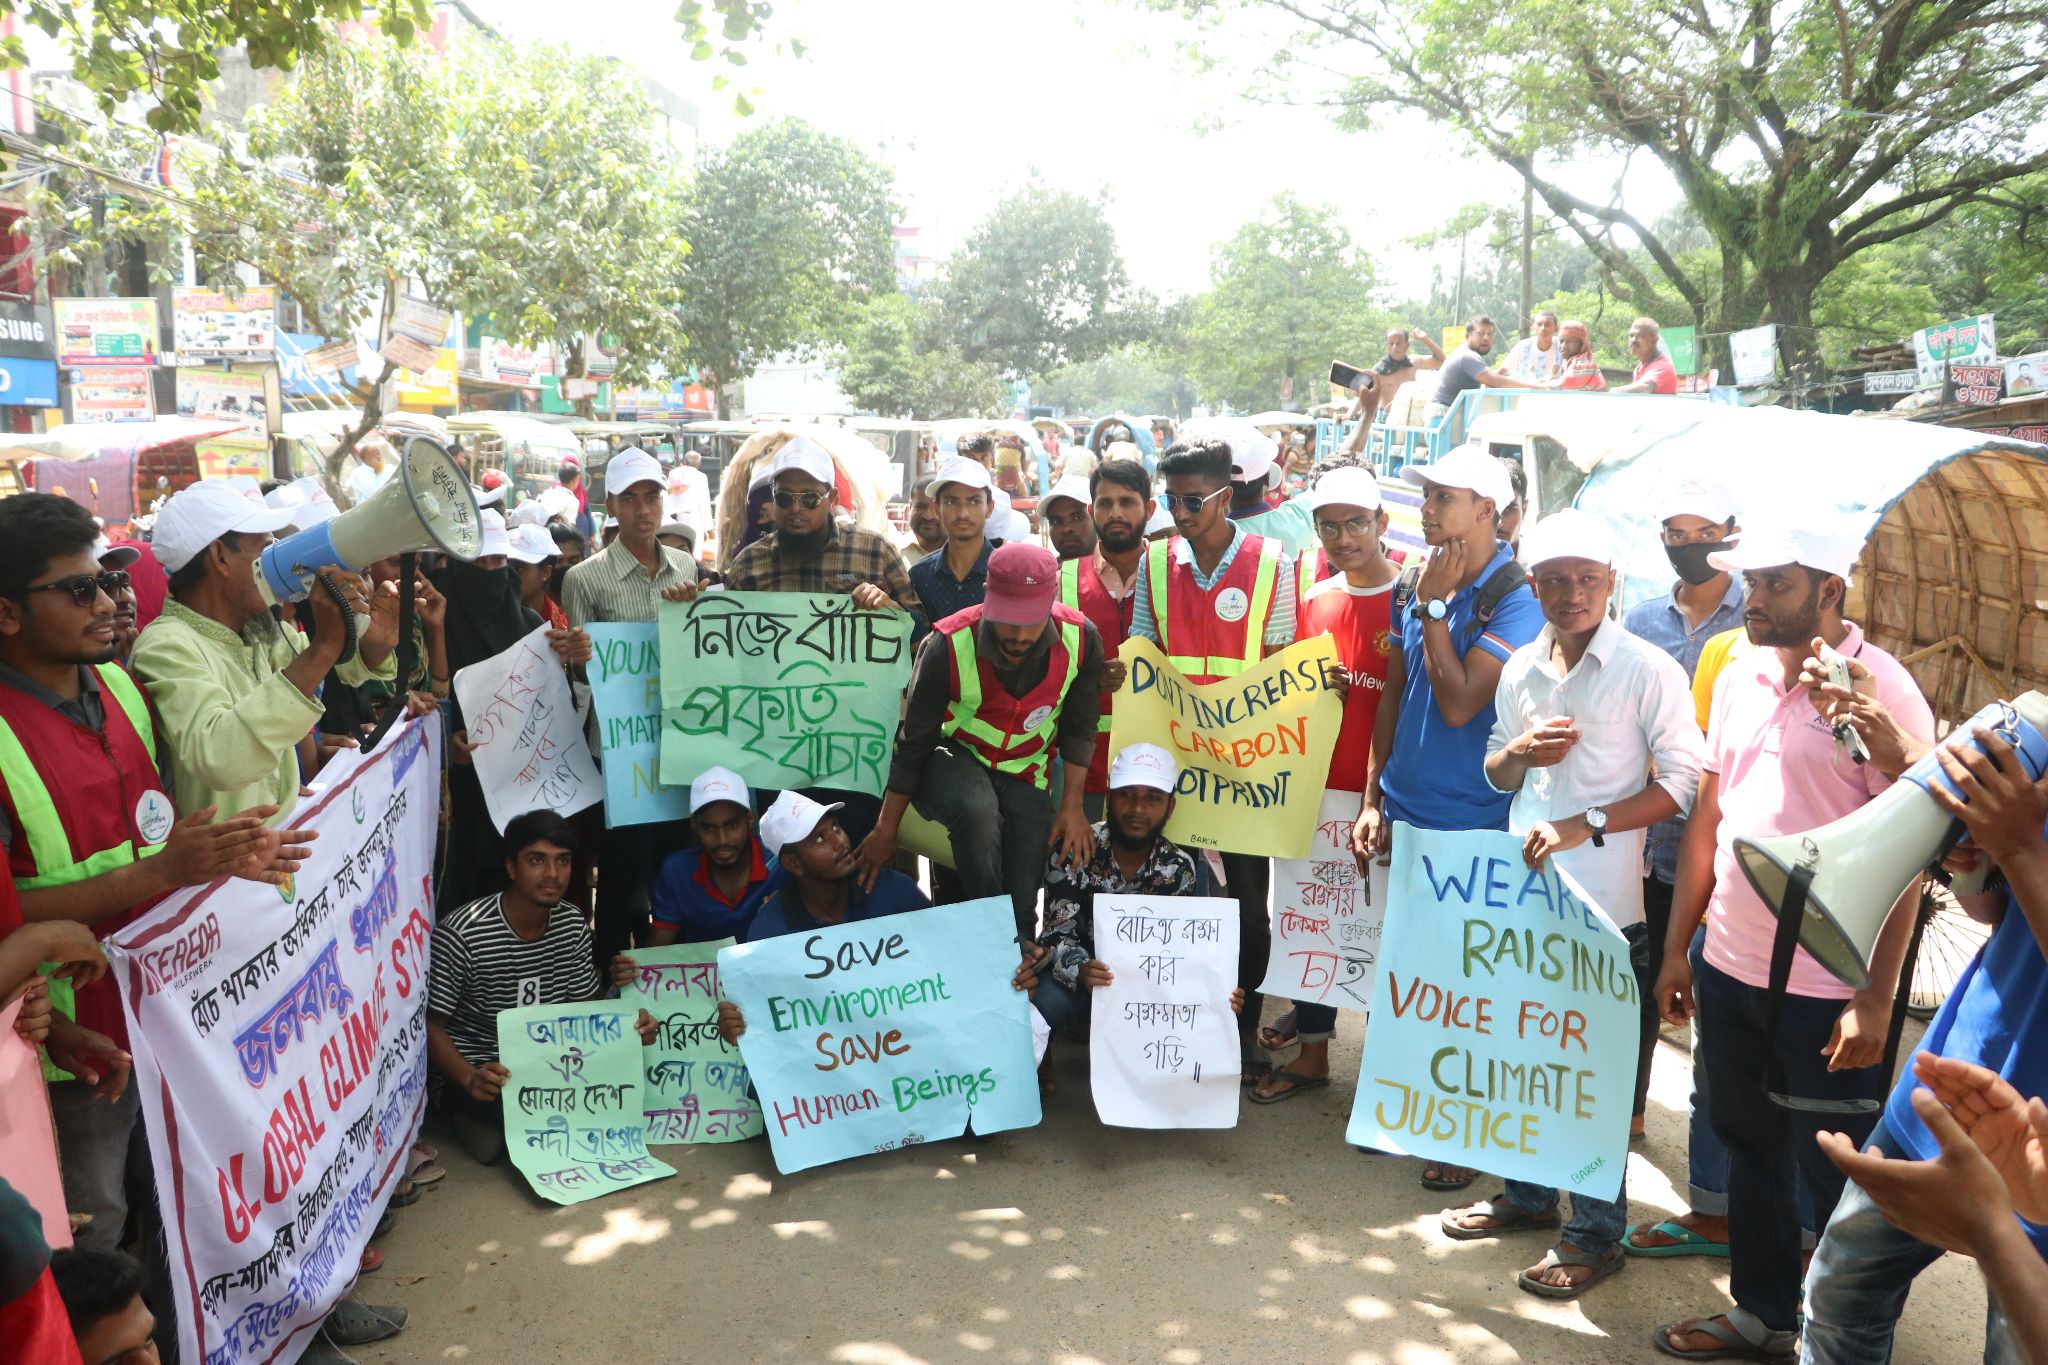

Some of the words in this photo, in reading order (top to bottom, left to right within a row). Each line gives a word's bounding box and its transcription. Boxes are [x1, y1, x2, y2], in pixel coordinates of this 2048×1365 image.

[594, 638, 660, 683] YOUN
[1187, 656, 1334, 729] INCREASE
[1170, 715, 1308, 767] CARBON
[1174, 766, 1292, 809] OTPRINT
[221, 940, 281, 1006] থাকার
[633, 962, 726, 1001] জলবা
[804, 934, 910, 980] Save
[1139, 949, 1185, 986] করি
[1288, 945, 1375, 1005] চাই
[232, 937, 354, 1089] জলবায়ু
[522, 980, 537, 1005] 8
[767, 972, 952, 1032] Enviroment
[1124, 1001, 1202, 1031] সক্ষমতা
[1388, 970, 1493, 1035] VOICE
[1518, 1000, 1588, 1054] FOR
[526, 1012, 633, 1046] আমাদের
[815, 1029, 912, 1072] Save
[519, 1086, 576, 1115] সোনার
[584, 1084, 635, 1114] দেশ
[774, 1088, 880, 1137] Human
[891, 1066, 996, 1113] Beings
[1430, 1045, 1597, 1120] CLIMATE
[525, 1115, 569, 1157] নদী
[1374, 1078, 1541, 1155] JUSTICE
[217, 1076, 326, 1244] GLOBAL
